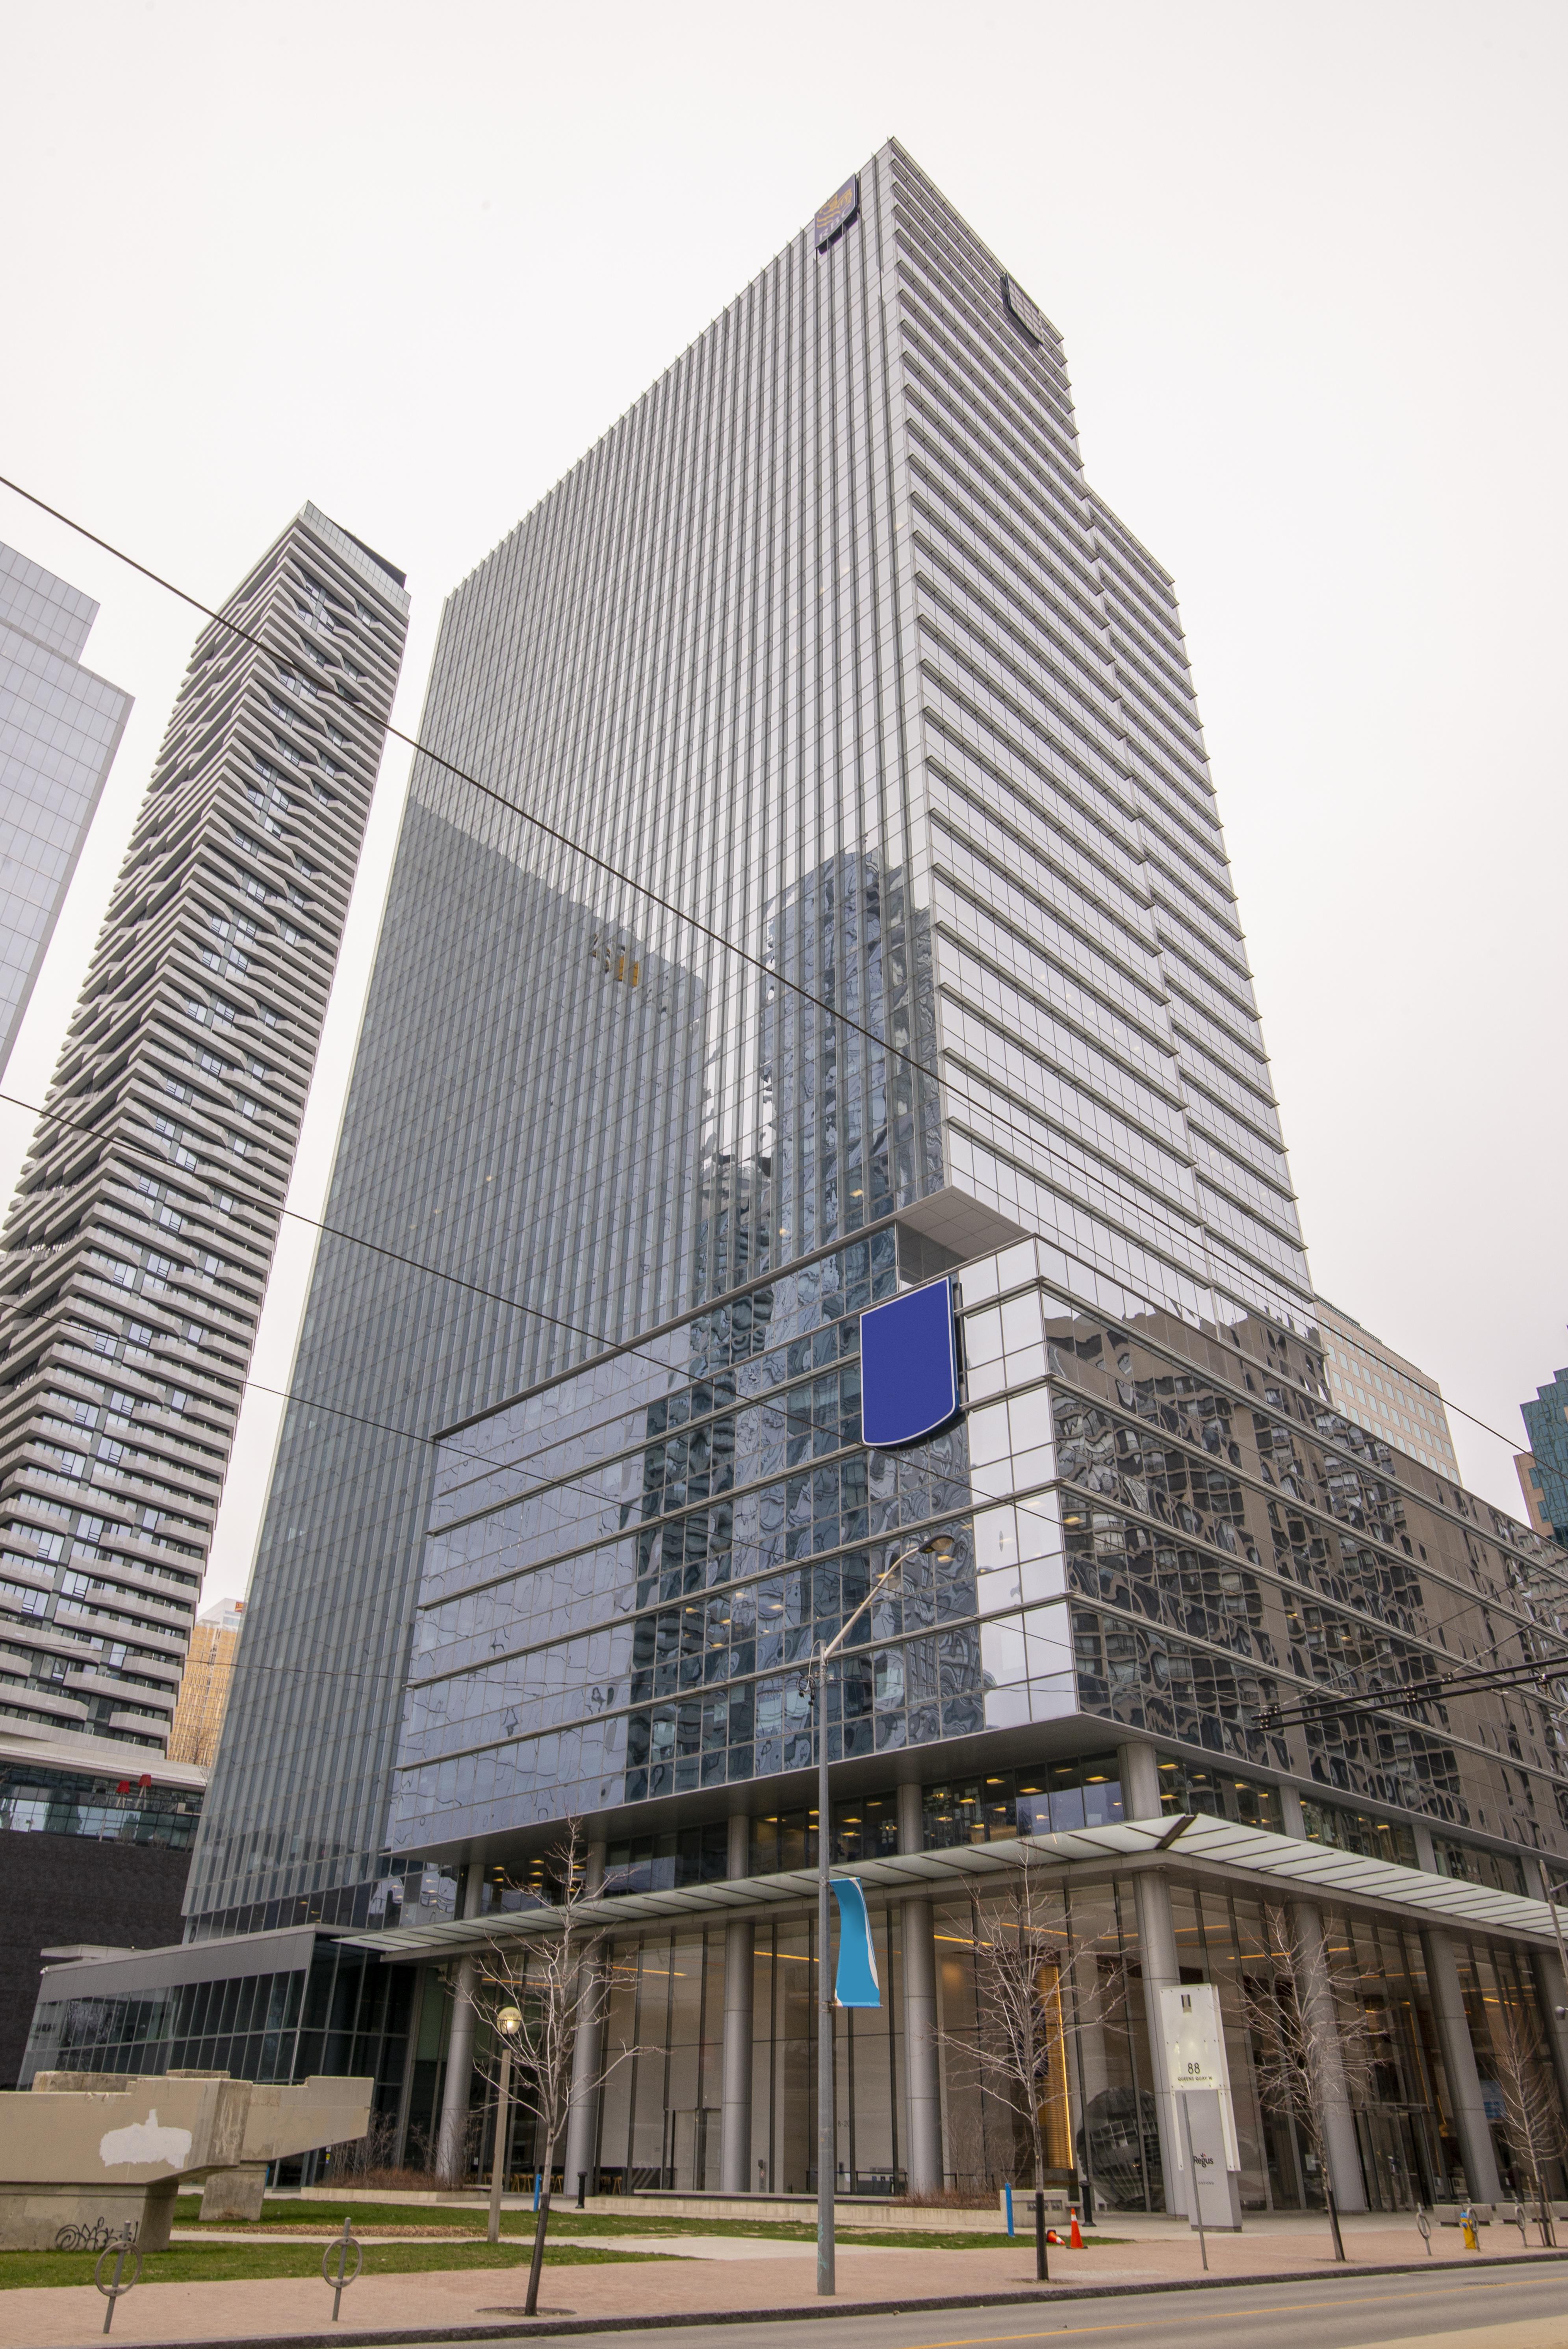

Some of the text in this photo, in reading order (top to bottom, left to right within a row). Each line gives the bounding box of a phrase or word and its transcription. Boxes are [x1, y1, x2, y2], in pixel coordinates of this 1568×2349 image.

[819, 204, 851, 242] RBC
[1188, 2062, 1200, 2074] 88
[1193, 2156, 1214, 2168] Regus
